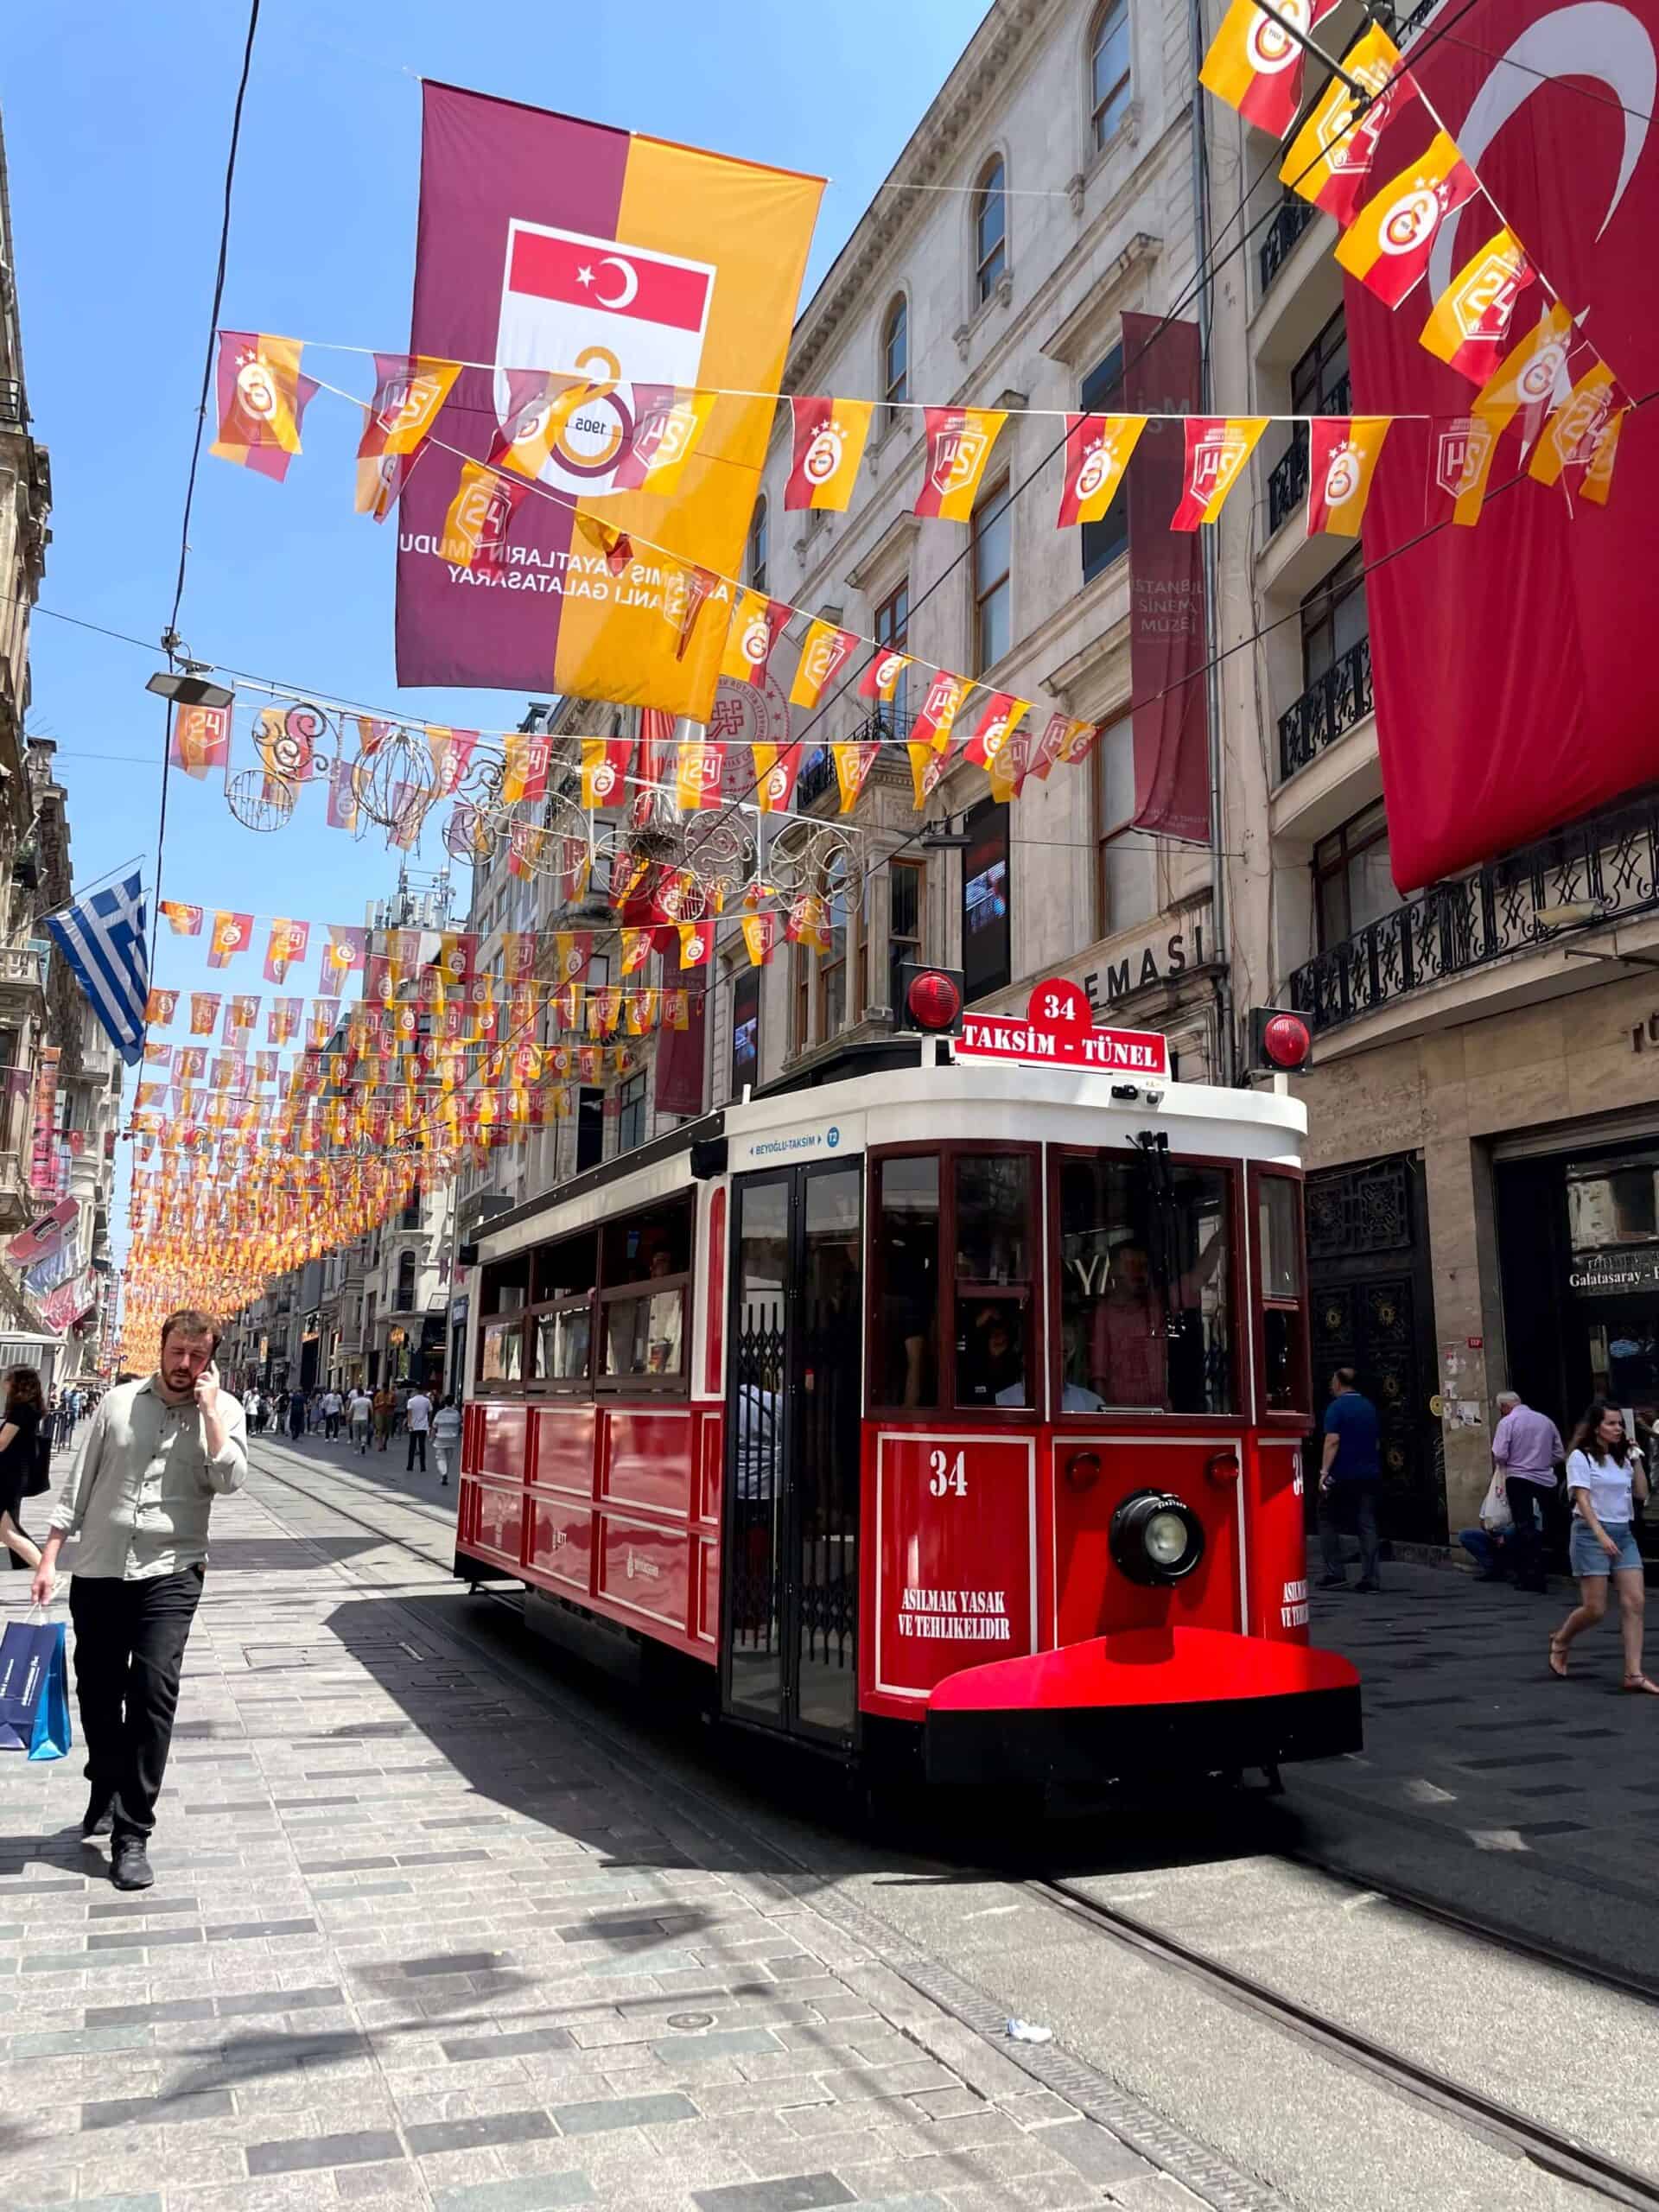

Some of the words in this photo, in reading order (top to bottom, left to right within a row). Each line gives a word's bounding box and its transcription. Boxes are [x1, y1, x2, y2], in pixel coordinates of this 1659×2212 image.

[1084, 926, 1204, 1009] EMASI
[1044, 995, 1075, 1020] 34
[963, 1025, 1055, 1056] TAKSİM
[1082, 1034, 1157, 1068] TÜNEL
[1569, 1271, 1641, 1287] Galatasaray
[930, 1450, 968, 1497] 34
[901, 1588, 957, 1613] ASILMAK
[959, 1591, 1005, 1613] YASAK
[898, 1614, 913, 1637] VE
